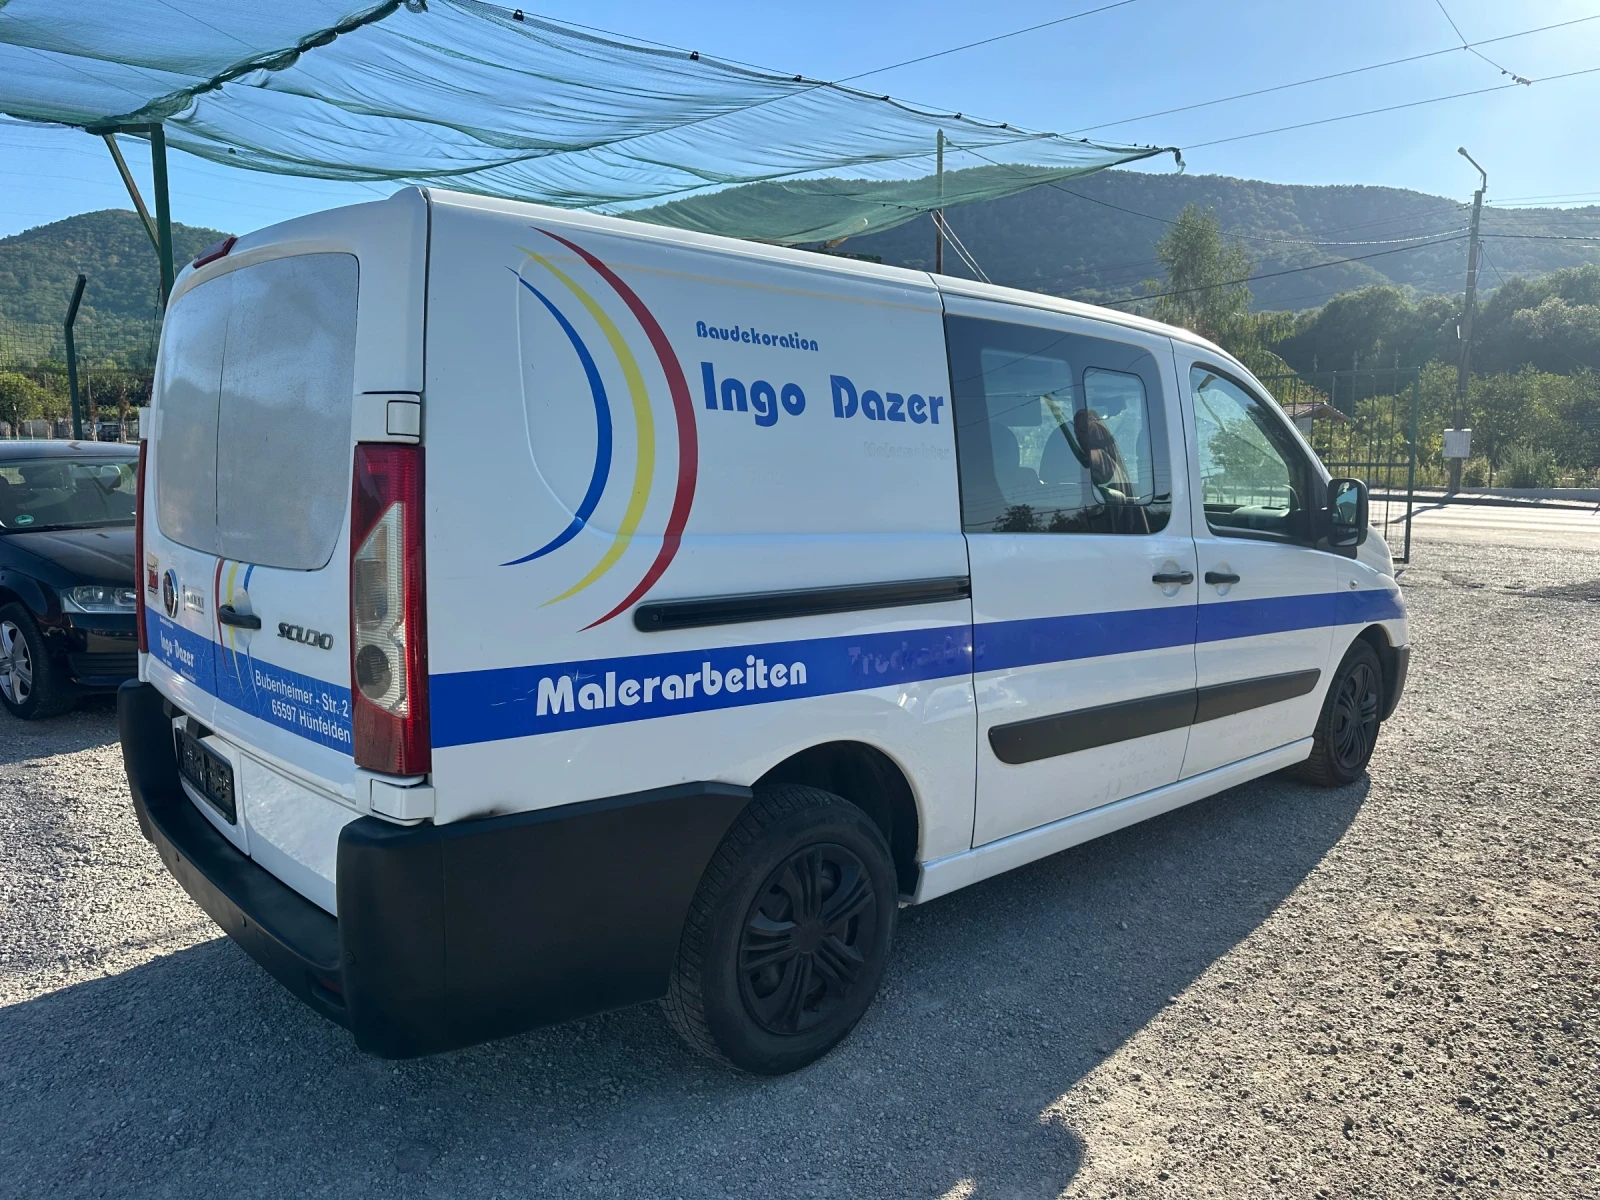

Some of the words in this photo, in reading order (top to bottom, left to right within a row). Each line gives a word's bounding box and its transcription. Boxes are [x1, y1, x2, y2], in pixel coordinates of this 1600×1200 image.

[696, 321, 819, 352] Baudekoration
[702, 362, 806, 427] Ingo
[830, 374, 944, 424] Dazer
[174, 639, 195, 668] Dazer
[277, 622, 334, 650] SCUDO
[255, 669, 313, 705] Bubenheimer
[322, 696, 340, 715] Str.
[342, 699, 349, 719] 2
[536, 655, 807, 716] Malerarbeiten
[271, 698, 297, 724] 65597
[299, 708, 351, 744] Hünfelden
